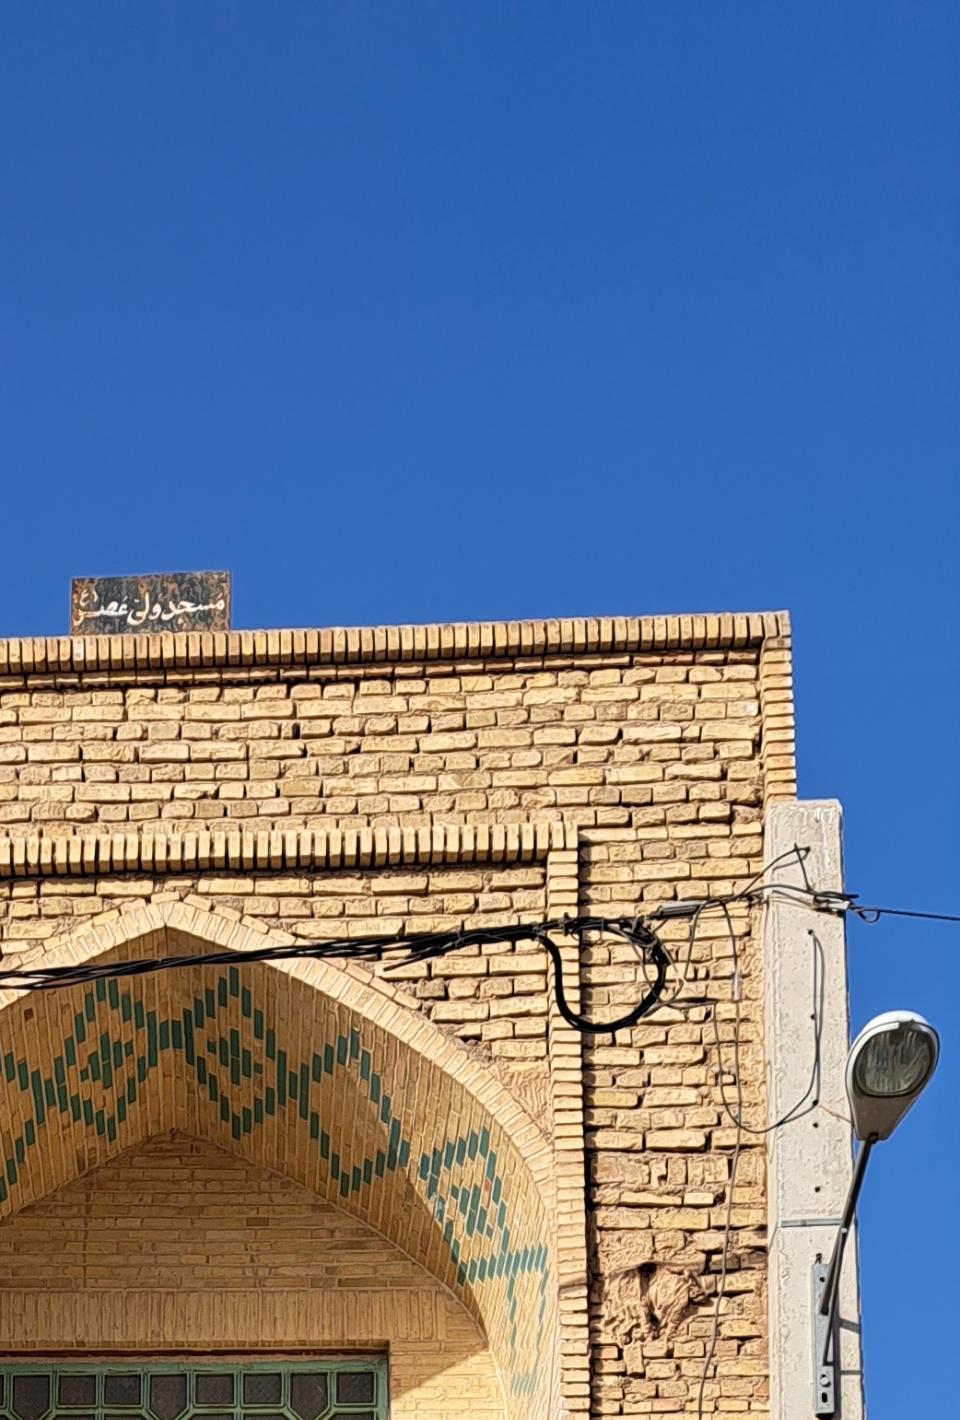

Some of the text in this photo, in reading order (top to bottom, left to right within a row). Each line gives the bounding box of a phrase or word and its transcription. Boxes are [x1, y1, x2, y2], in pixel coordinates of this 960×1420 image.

[73, 596, 129, 626] عصر
[126, 592, 162, 626] ولی
[161, 595, 226, 625] مسجد
